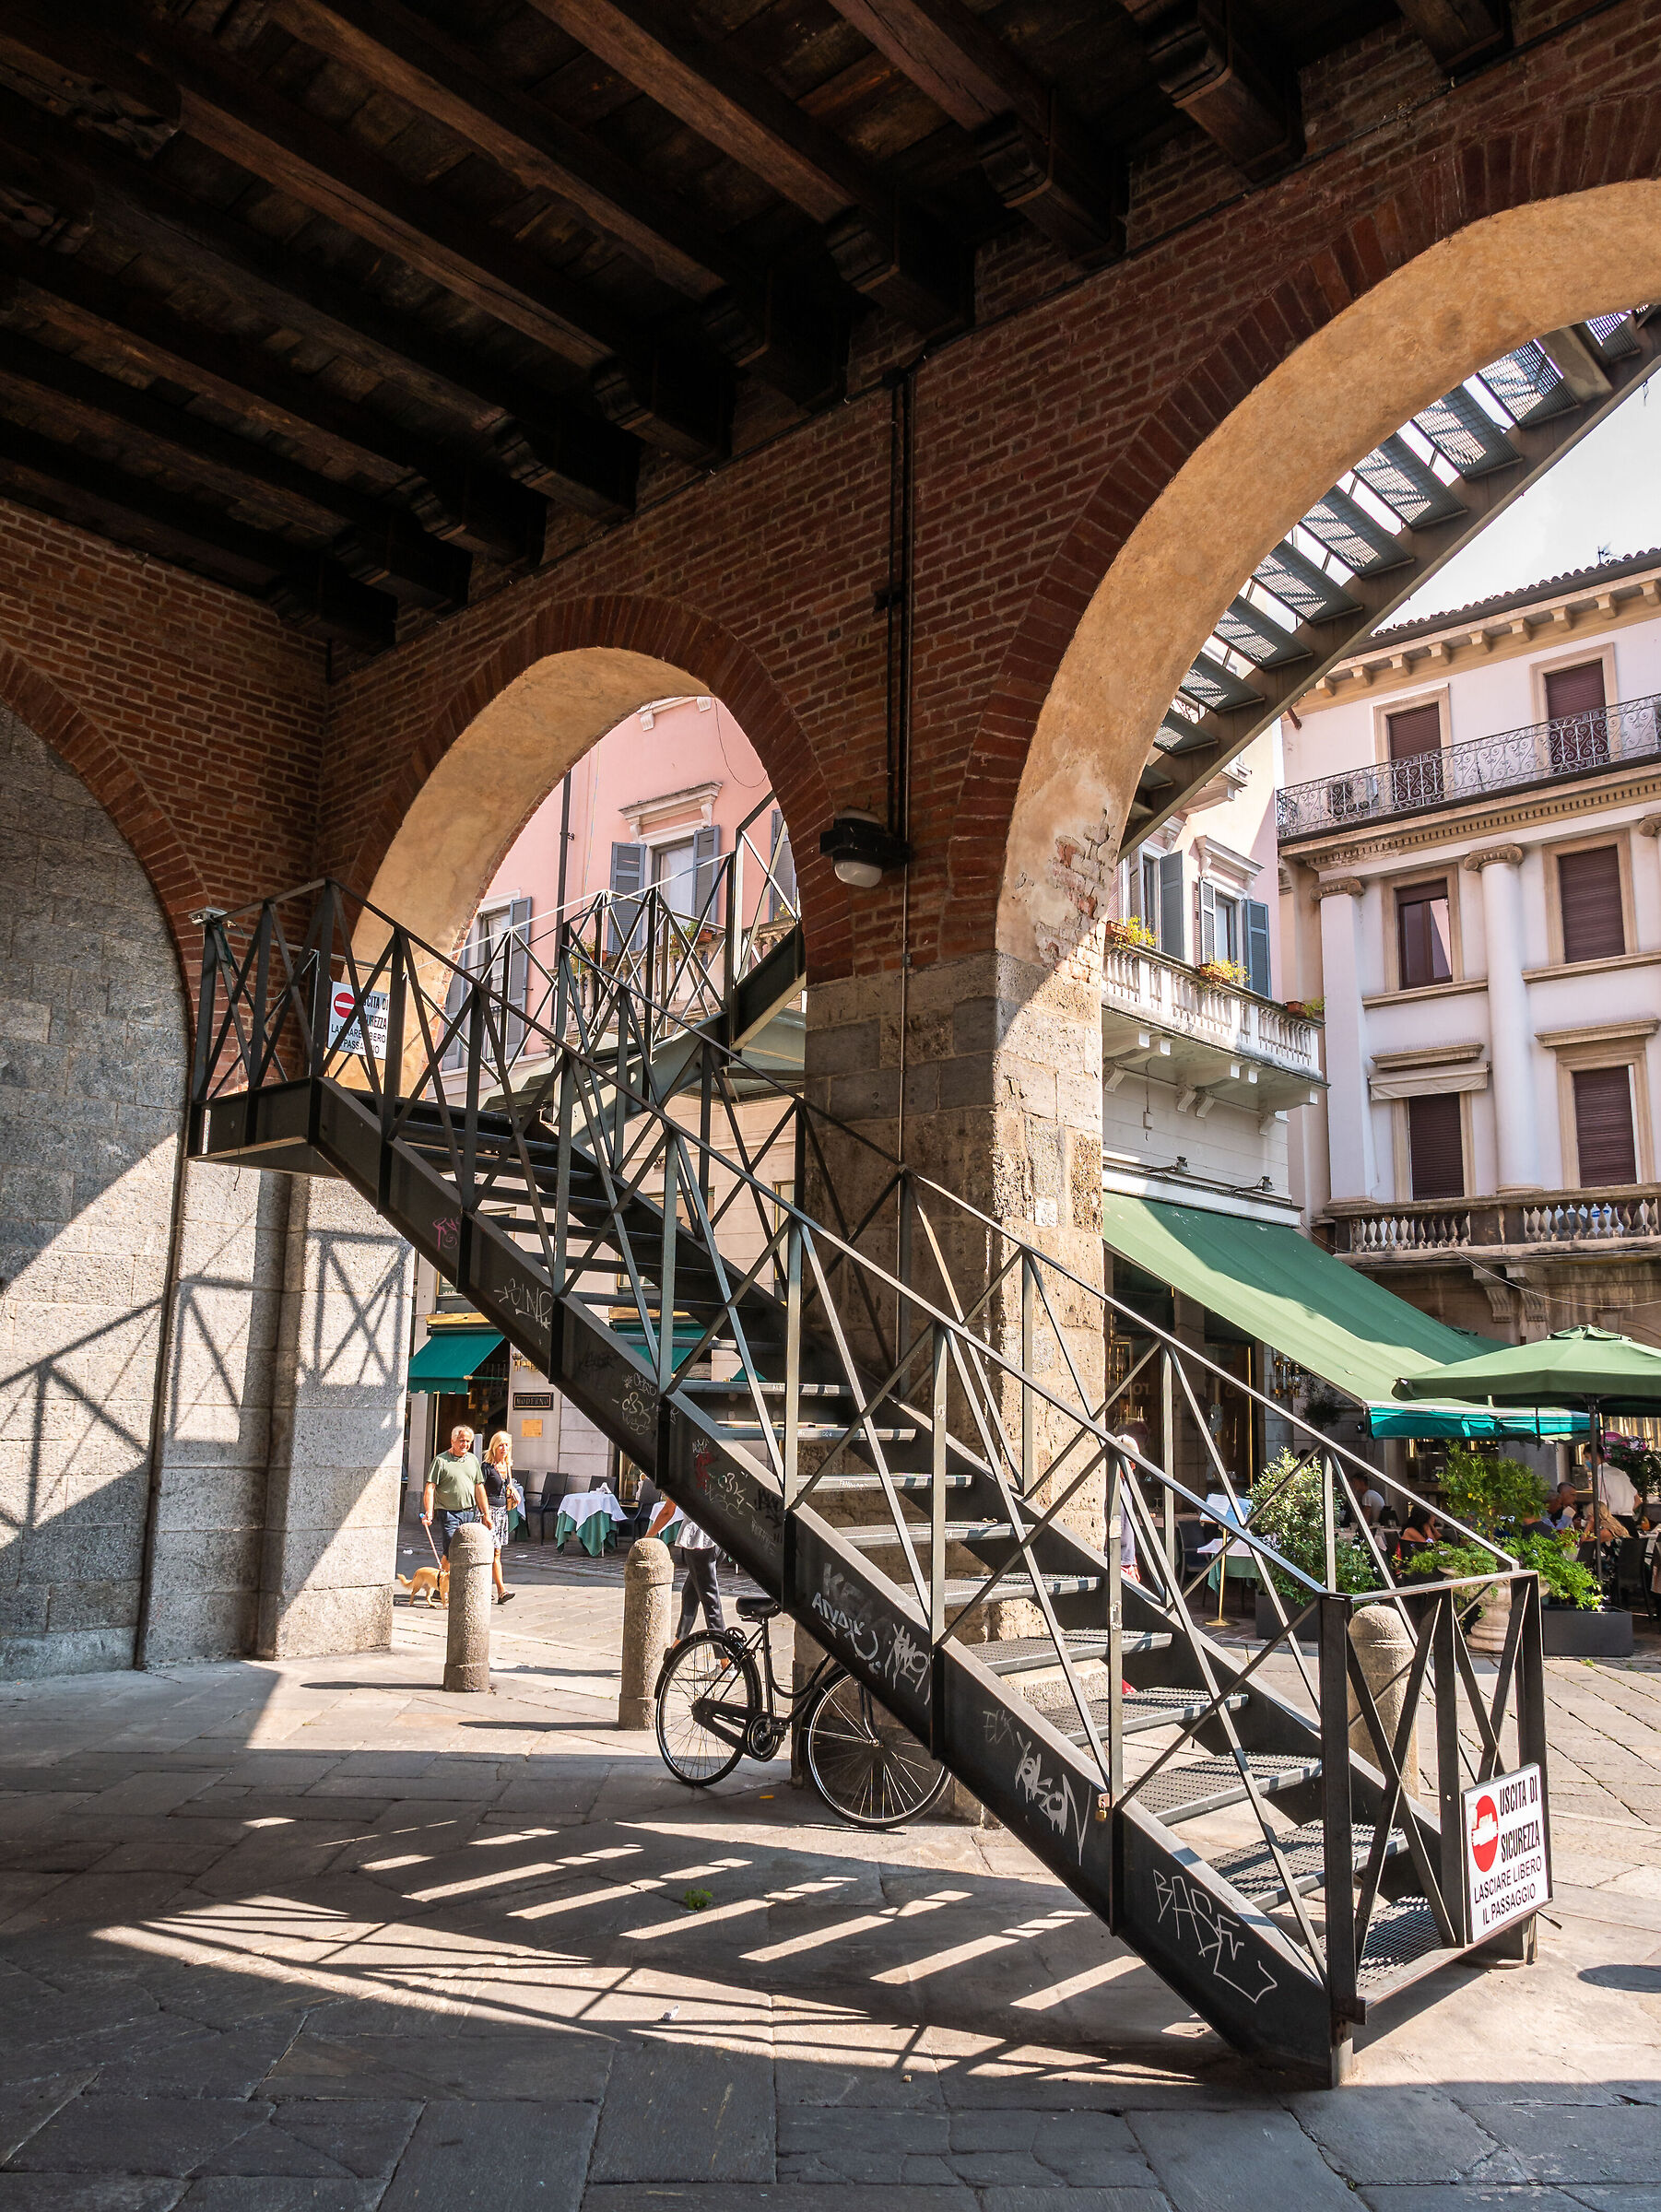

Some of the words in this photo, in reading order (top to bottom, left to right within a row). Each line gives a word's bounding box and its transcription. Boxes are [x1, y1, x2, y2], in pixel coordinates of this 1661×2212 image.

[358, 1013, 387, 1030] UREZZA
[516, 1397, 549, 1406] MODERNO
[1500, 1780, 1527, 1817] USCITA
[1529, 1775, 1538, 1804] DI
[1501, 1819, 1540, 1863] SICUREZZA
[1474, 1868, 1512, 1904] LASCIARE
[1513, 1855, 1542, 1883] LIBERO
[1482, 1908, 1490, 1926] IL
[1490, 1882, 1537, 1921] PASSAGGIO
